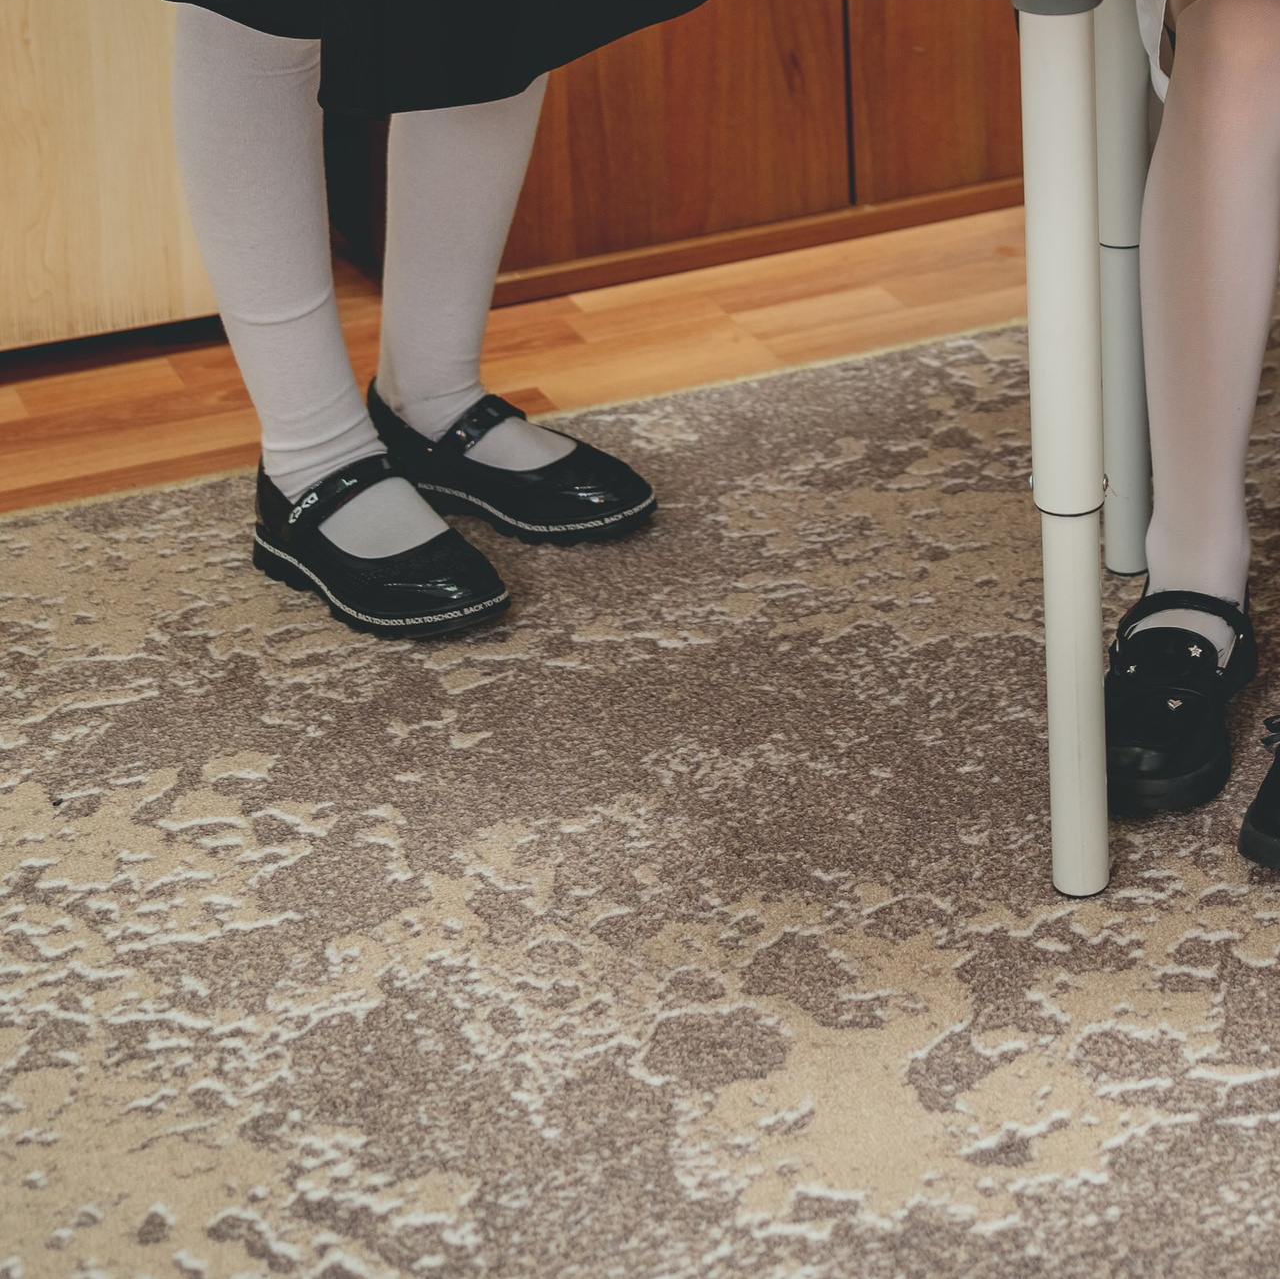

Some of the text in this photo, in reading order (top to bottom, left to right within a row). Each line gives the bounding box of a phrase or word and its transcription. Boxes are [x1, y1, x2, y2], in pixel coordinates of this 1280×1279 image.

[604, 513, 623, 525] BACK
[405, 617, 424, 625] BACK
[423, 616, 433, 624] TO
[432, 611, 463, 623] SCHOOL
[463, 603, 484, 615] BACK
[483, 599, 494, 608] TO
